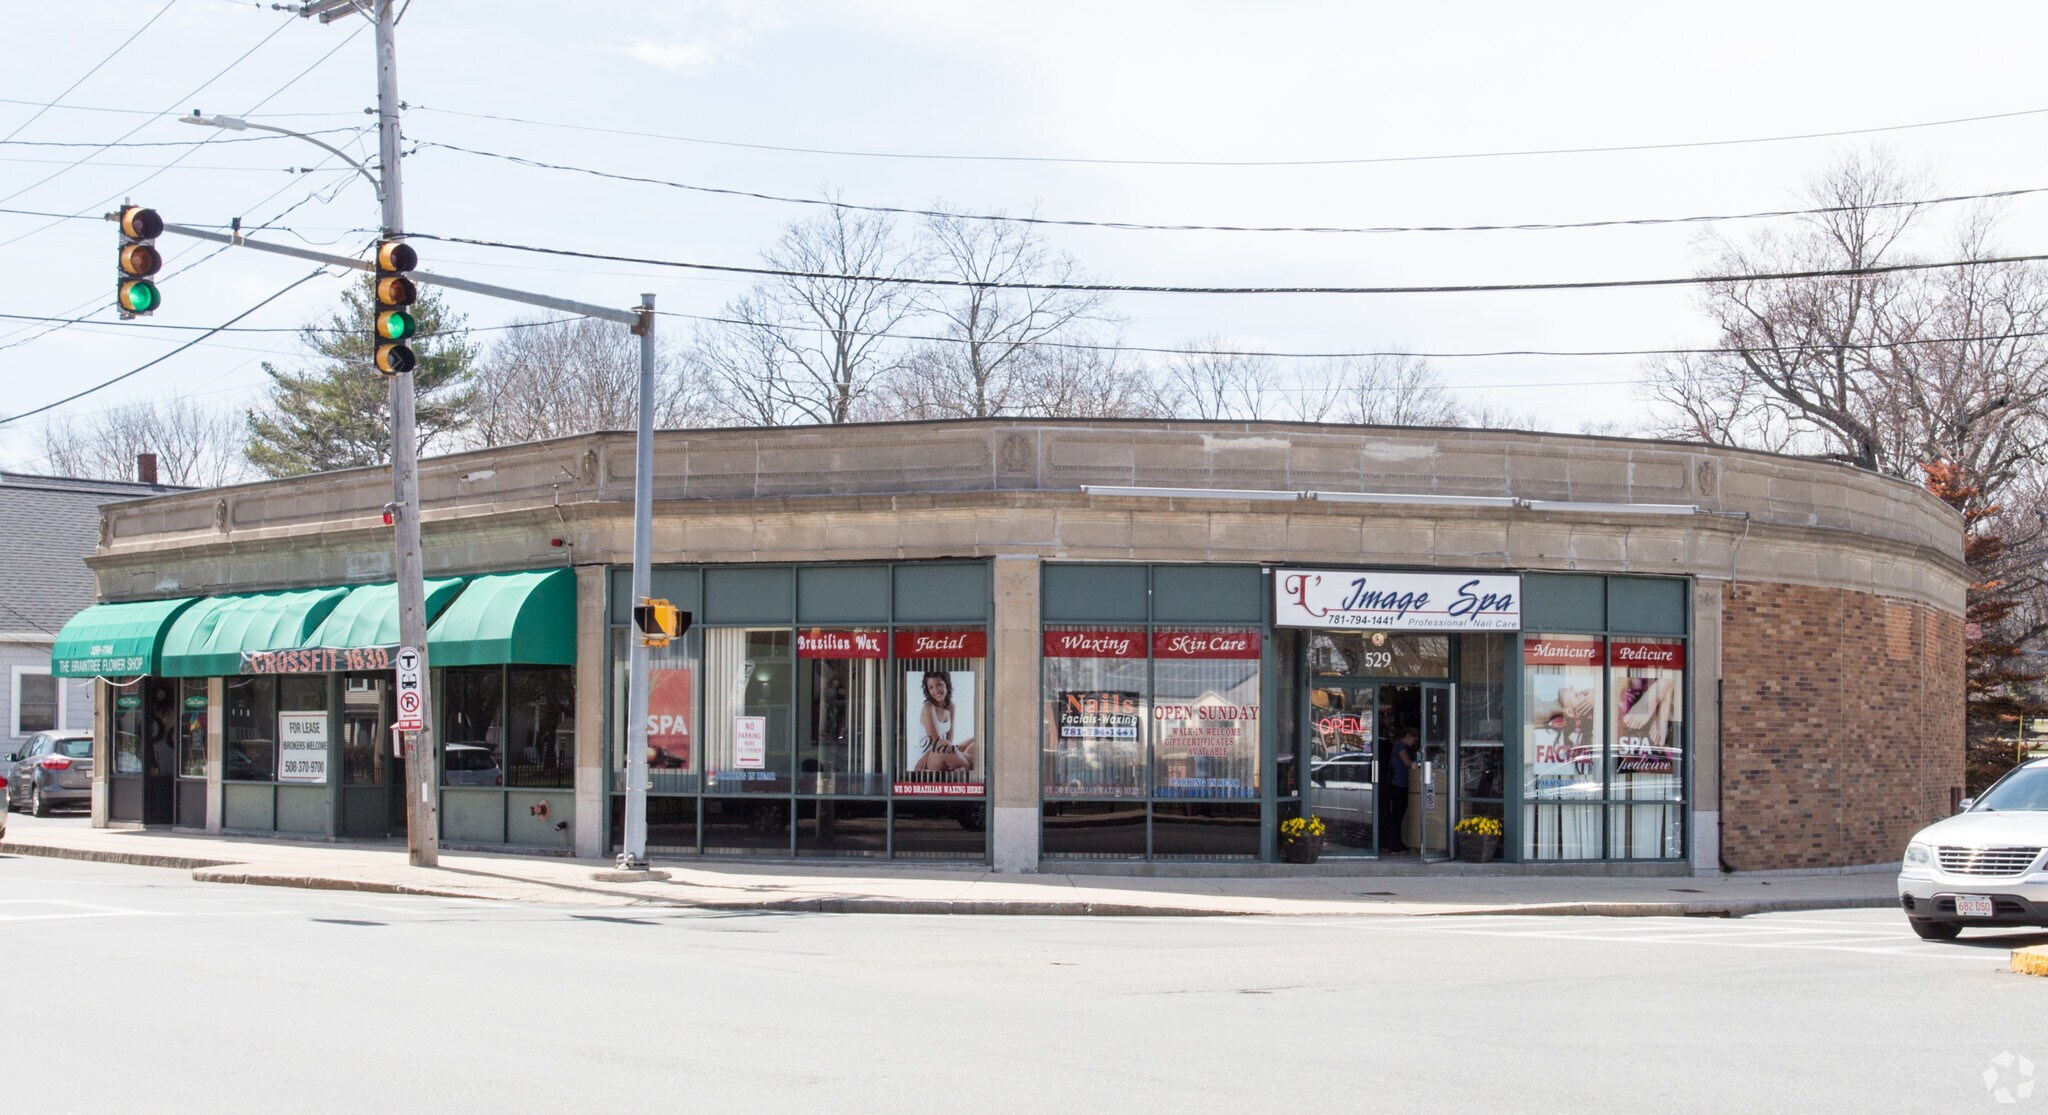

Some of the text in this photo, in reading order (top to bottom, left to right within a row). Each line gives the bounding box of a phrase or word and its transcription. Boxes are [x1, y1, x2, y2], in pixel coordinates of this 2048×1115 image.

[1342, 577, 1430, 620] Image
[1448, 579, 1515, 621] Spa
[1328, 614, 1518, 629] 781-794-1441 Professional Nail Care
[798, 633, 880, 652] Brazilian Wax
[915, 634, 966, 652] Facial
[1061, 634, 1130, 655] Waxing
[1168, 635, 1246, 654] Skin Care
[1533, 642, 1596, 658] Manicure
[251, 647, 389, 674] CROSSFIT 1630
[1365, 652, 1392, 667] 529
[1619, 645, 1673, 661] Pedicure
[60, 657, 143, 672] THE BRAINTREE FLOWER SHOP
[1065, 693, 1135, 714] Nails
[1061, 713, 1138, 727] Facials-Waxing
[1154, 705, 1260, 720] OPEN SUNDAY
[289, 721, 321, 734] FOR LEASE
[646, 714, 688, 735] SPA
[744, 722, 755, 731] NO
[1171, 727, 1242, 737] WALK-IN WELCOME
[1319, 717, 1363, 734] OPEN
[737, 732, 762, 740] PARKING
[1164, 737, 1234, 747] GIFT CERTIFICATES
[283, 740, 328, 751] BROKERS WELCOME
[919, 735, 959, 754] Wax
[1187, 747, 1229, 756] AVAILABLE
[1618, 736, 1653, 755] SPA
[1536, 744, 1594, 764] FACIAL
[284, 760, 325, 773] 508-370-9700
[1616, 754, 1672, 773] pedicure
[894, 785, 904, 793] WE
[904, 785, 912, 793] DO
[913, 785, 943, 793] BRAZILIAN
[943, 785, 966, 794] WAXING
[1171, 777, 1240, 787] PARKING IN REAR
[1958, 901, 1974, 911] 682
